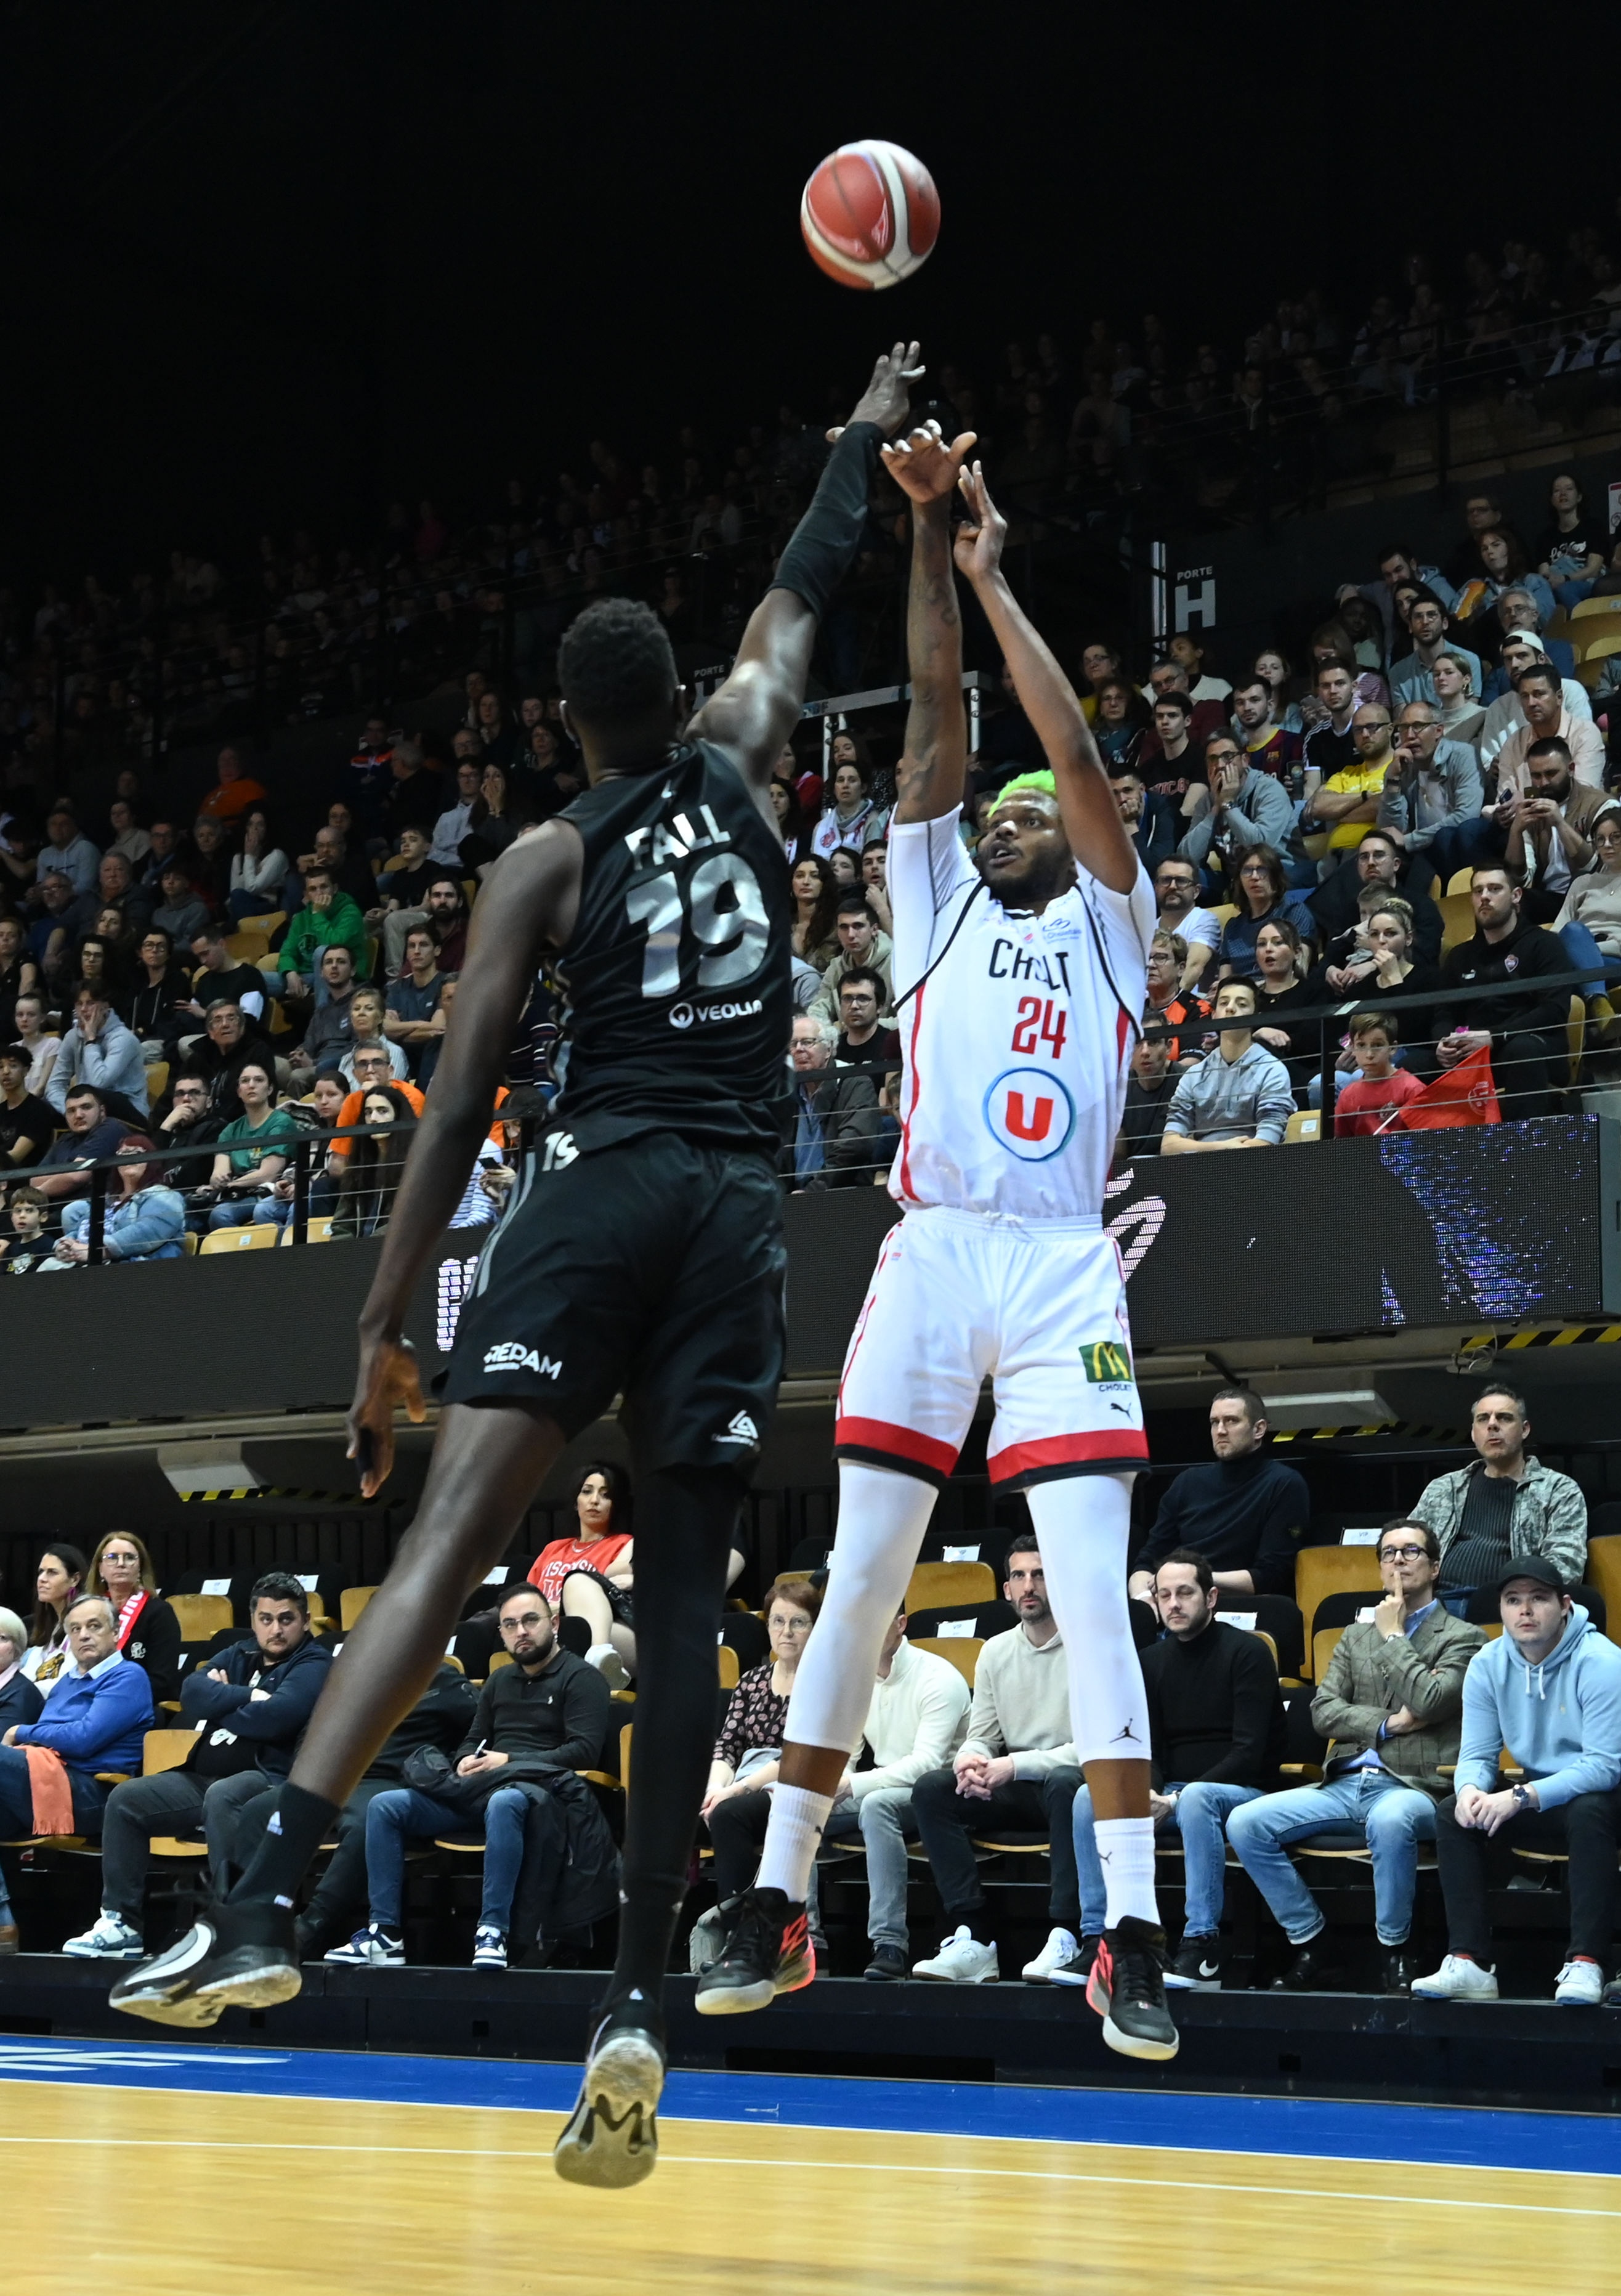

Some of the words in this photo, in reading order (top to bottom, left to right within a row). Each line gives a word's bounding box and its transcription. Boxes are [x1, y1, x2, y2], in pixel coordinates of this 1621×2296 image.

[1176, 566, 1213, 581] PORTE
[1174, 579, 1216, 633] H
[694, 665, 724, 678] PORTE
[625, 804, 731, 870] FALL
[626, 852, 770, 998] 19
[696, 1000, 763, 1023] VEOLIA
[1011, 996, 1067, 1060] 24
[1005, 1090, 1054, 1142] U
